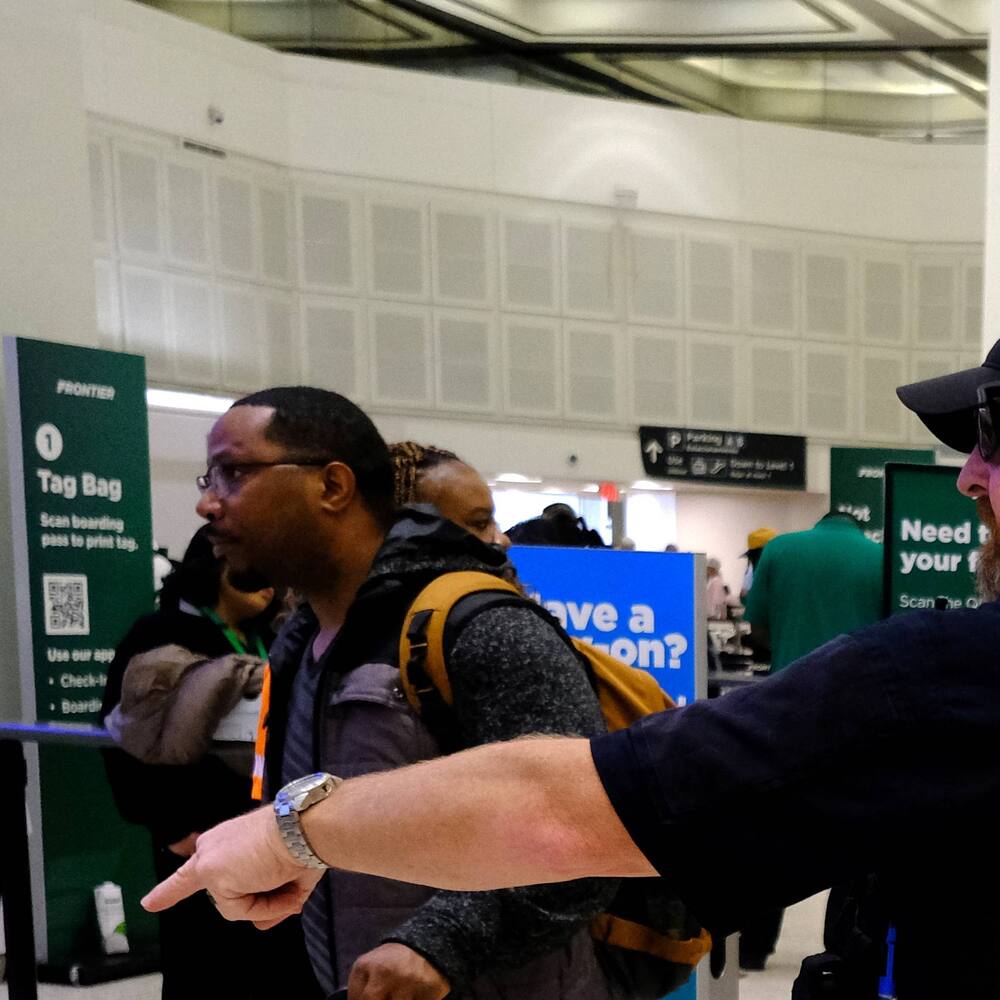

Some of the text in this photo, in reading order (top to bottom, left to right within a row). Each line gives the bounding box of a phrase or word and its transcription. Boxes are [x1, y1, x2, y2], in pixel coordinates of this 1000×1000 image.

[56, 379, 116, 400] FRONTIER
[37, 468, 122, 502] Tag Bag
[40, 512, 124, 533] Scan boarding
[901, 518, 971, 544] Need
[41, 533, 69, 548] pass
[71, 533, 84, 548] to
[86, 534, 114, 550] print
[900, 550, 961, 574] your
[900, 595, 934, 608] Scan
[529, 592, 654, 633] ave a
[47, 647, 115, 663] Use our app
[62, 698, 102, 714] Boardi
